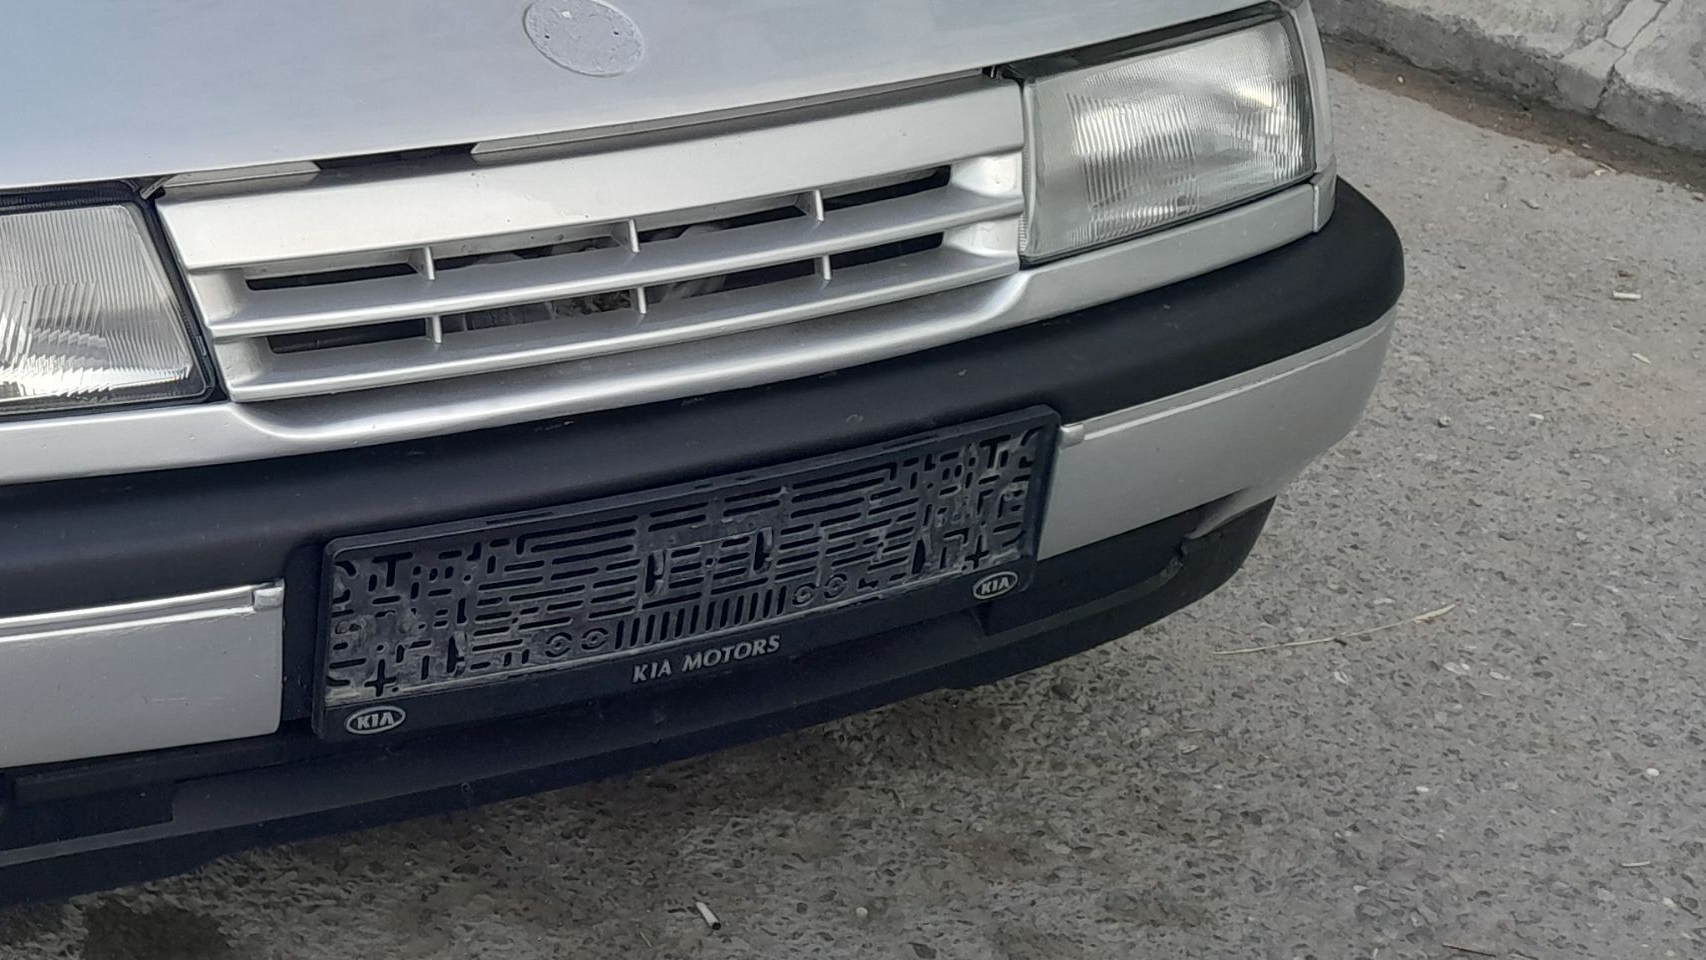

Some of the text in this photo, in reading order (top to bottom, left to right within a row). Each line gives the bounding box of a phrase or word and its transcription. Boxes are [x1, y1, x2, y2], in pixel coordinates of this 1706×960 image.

[980, 576, 1011, 595] KIA
[632, 634, 781, 683] KIA MOTORS
[356, 711, 395, 730] KIA
